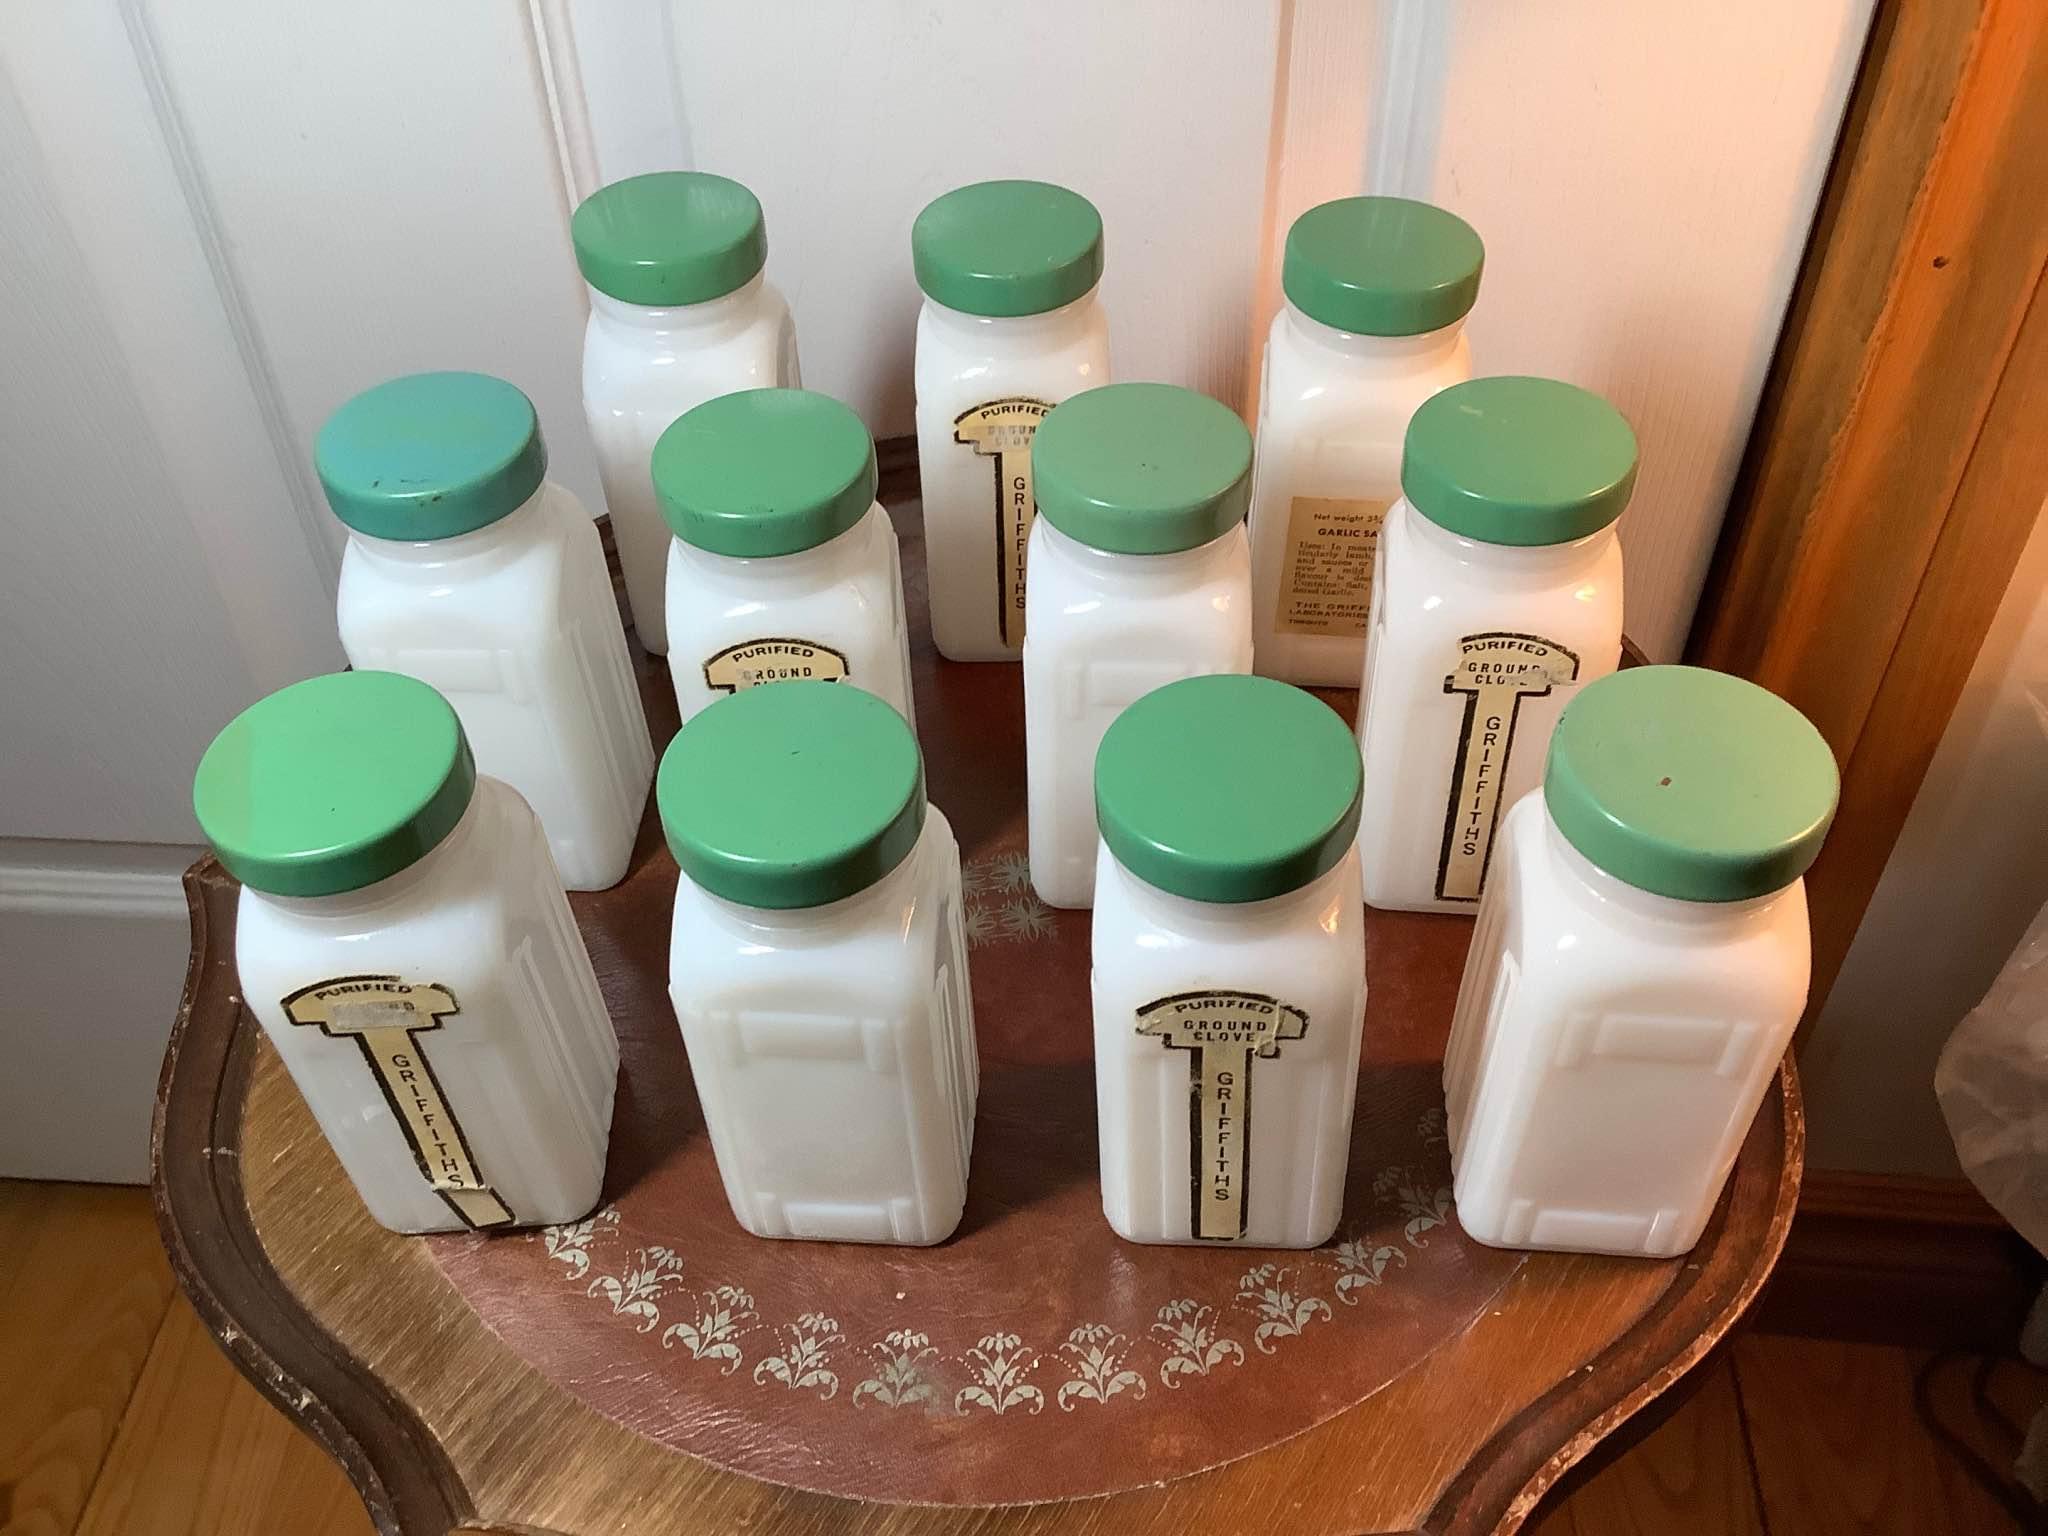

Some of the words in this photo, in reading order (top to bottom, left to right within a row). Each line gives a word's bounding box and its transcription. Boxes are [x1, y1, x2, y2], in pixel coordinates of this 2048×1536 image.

[1334, 514, 1364, 523] weight
[1318, 528, 1360, 537] GARLIC
[1013, 476, 1026, 609] GRIFFITHS
[1296, 601, 1321, 609] THE
[732, 645, 814, 662] PURIFIED
[1462, 640, 1548, 657] PURIFIED
[1462, 716, 1502, 856] GRIFFITHS
[314, 983, 413, 1001] PURIFIED
[1174, 1000, 1274, 1015] PURIFIED
[1183, 1020, 1267, 1031] GROUND
[391, 1054, 464, 1188] GRIFFITHS
[1215, 1072, 1234, 1201] GRIFFITHS
